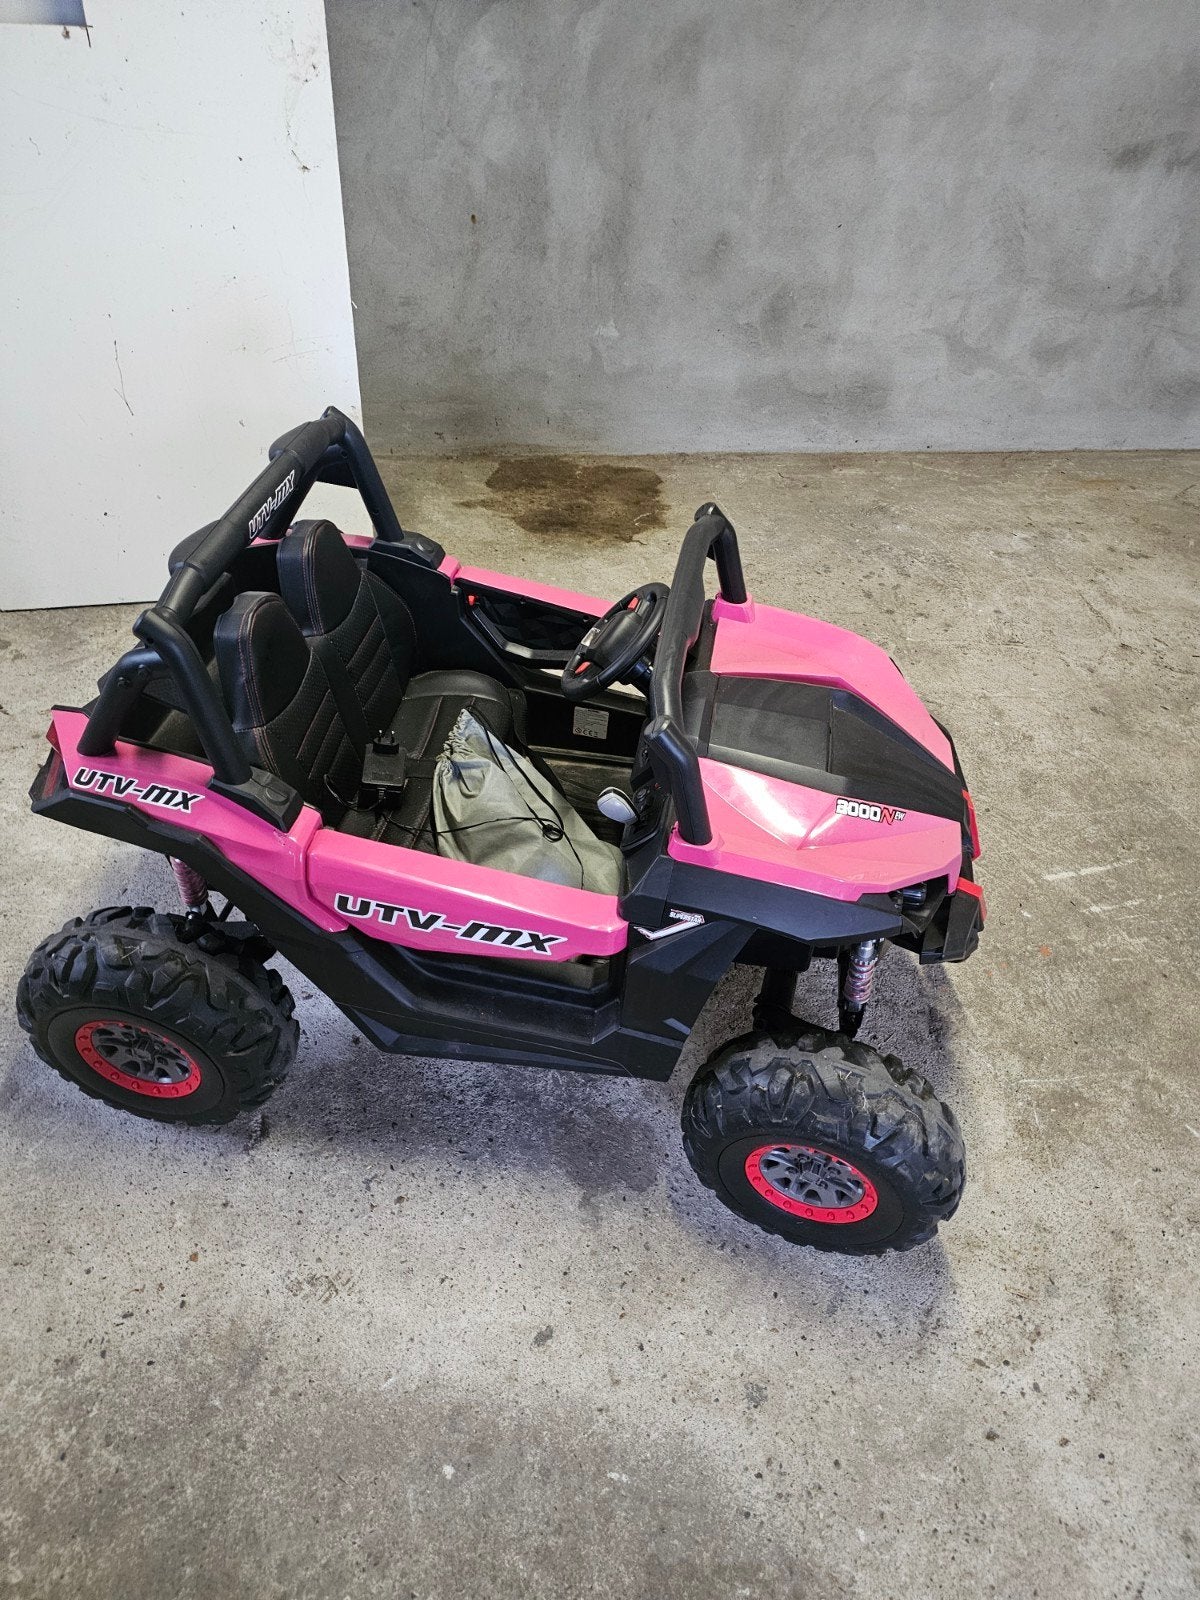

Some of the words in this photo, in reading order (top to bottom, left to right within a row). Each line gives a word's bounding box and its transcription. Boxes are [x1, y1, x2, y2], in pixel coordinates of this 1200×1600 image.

[248, 469, 295, 540] UTV-MX
[73, 766, 205, 814] UTV-MX
[334, 892, 568, 956] UTV-MX
